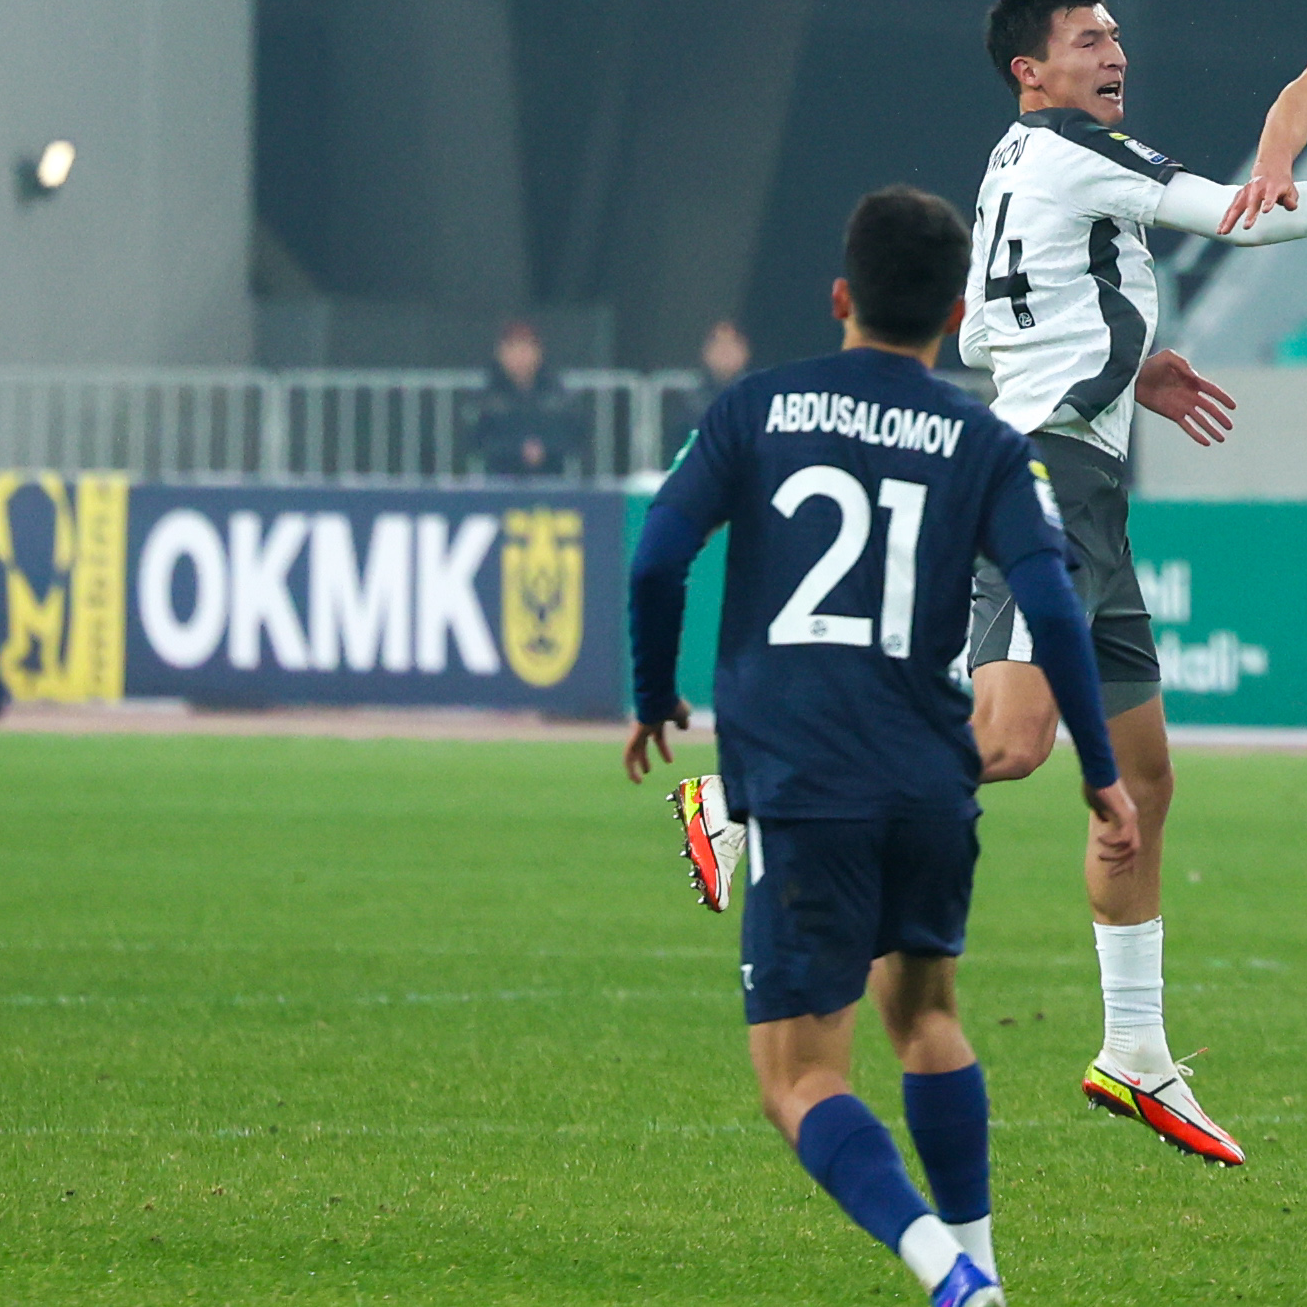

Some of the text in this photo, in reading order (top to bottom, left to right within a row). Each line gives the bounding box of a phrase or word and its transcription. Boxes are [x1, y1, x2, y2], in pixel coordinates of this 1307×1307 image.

[765, 392, 964, 458] ABDUSALOMOV
[138, 508, 500, 674] OKMK
[767, 464, 928, 660] 21
